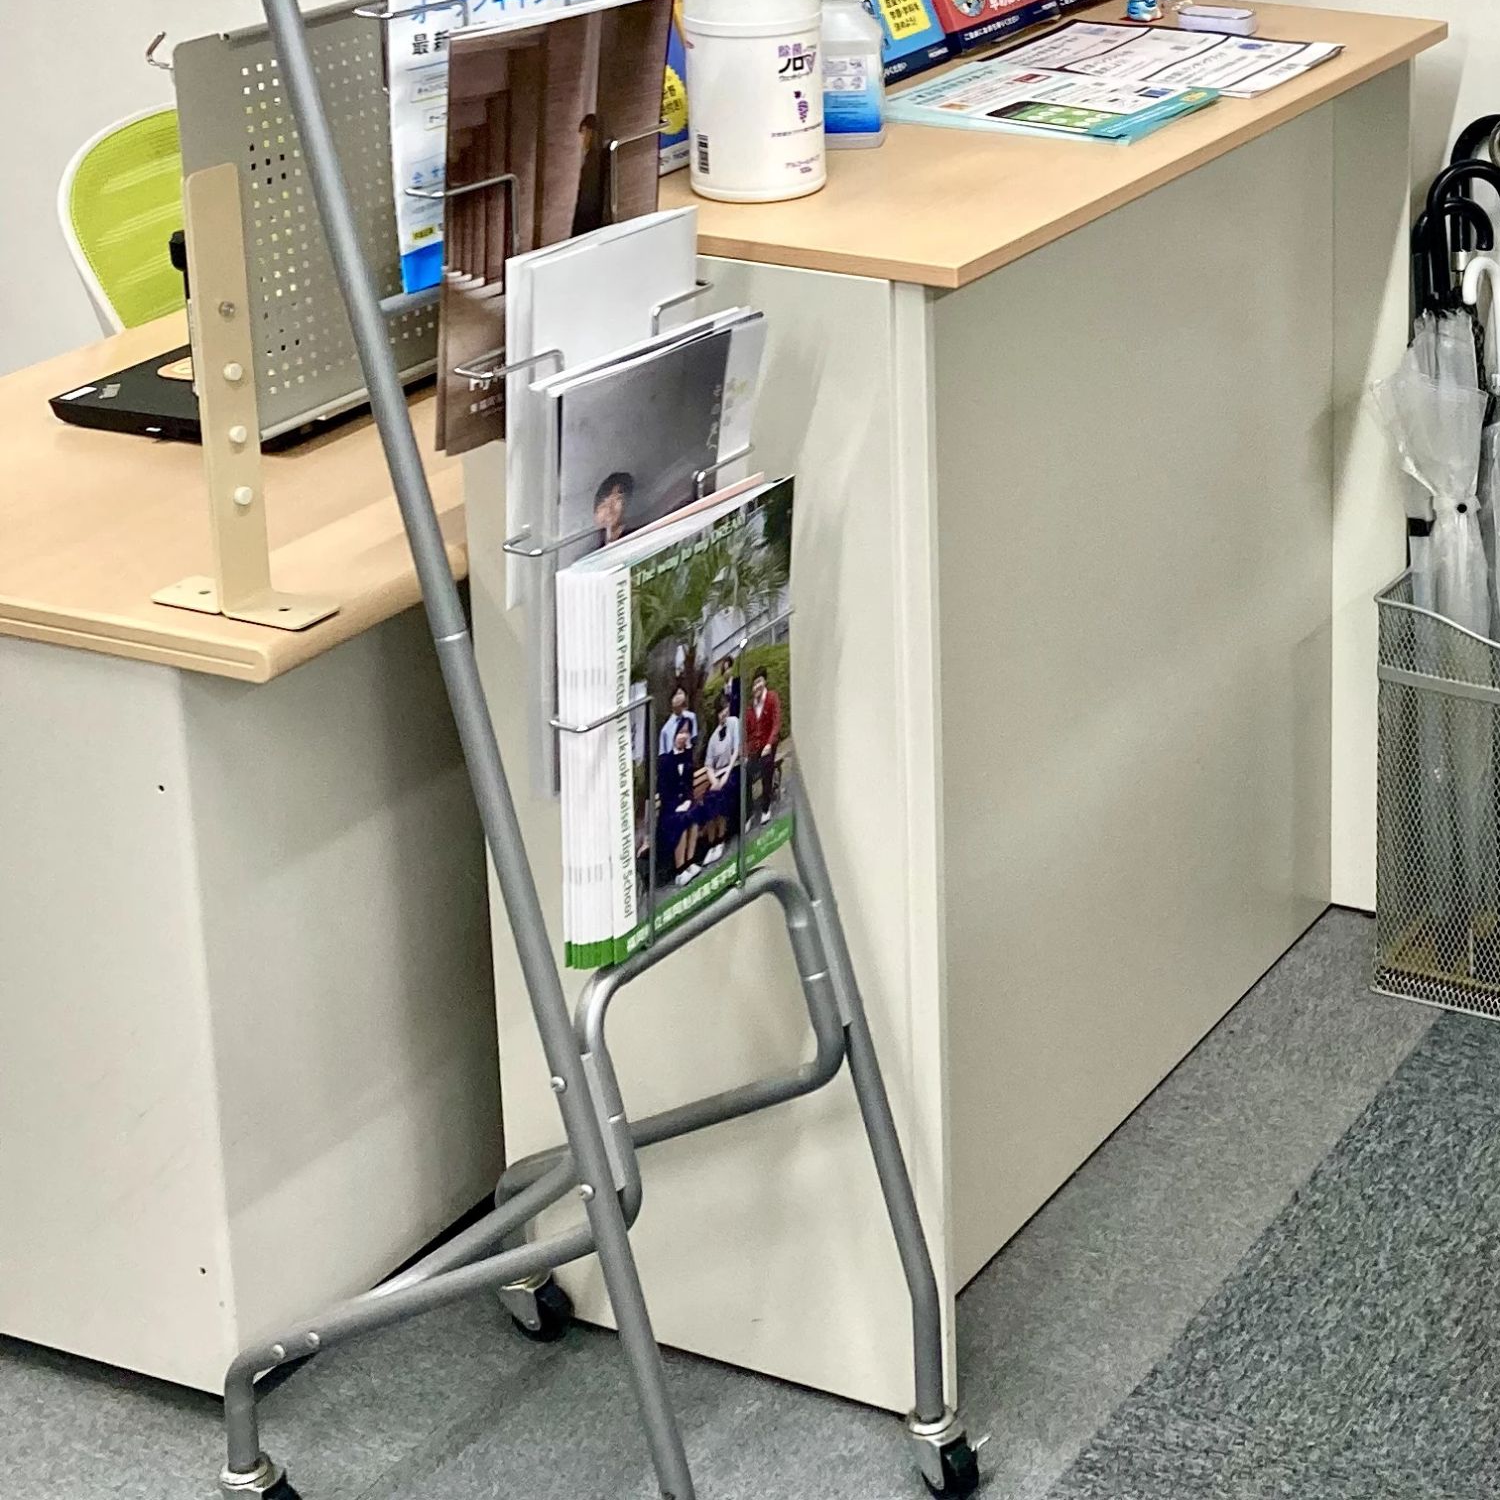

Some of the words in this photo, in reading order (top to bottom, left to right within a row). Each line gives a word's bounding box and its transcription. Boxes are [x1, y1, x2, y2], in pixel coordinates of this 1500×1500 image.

[616, 579, 628, 644] Fukuoka
[617, 724, 630, 789] Fukuoka
[620, 834, 633, 866] High
[622, 870, 634, 919] School
